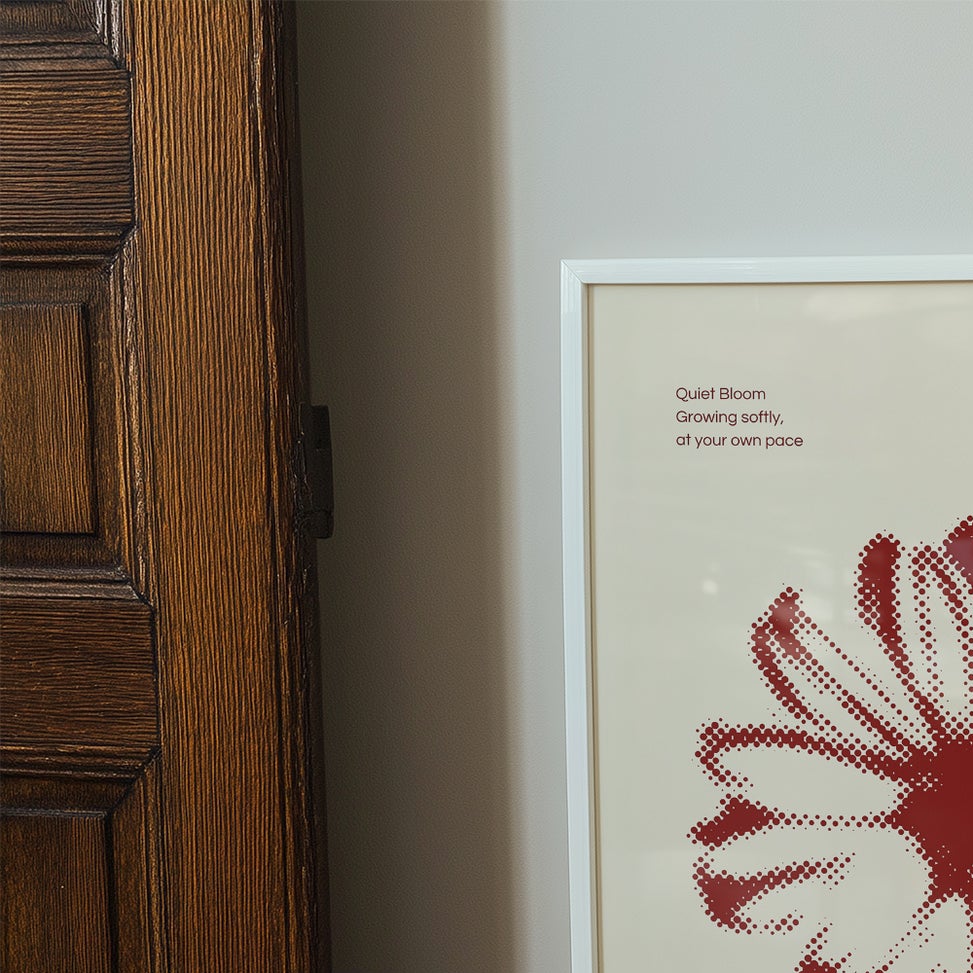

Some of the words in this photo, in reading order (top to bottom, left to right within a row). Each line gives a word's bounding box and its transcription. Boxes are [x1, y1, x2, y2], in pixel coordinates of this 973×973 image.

[675, 386, 715, 403] Quiet
[719, 386, 766, 401] Bloom
[675, 409, 738, 427] Growing
[740, 409, 784, 427] softly,
[675, 433, 692, 446] at
[694, 436, 728, 450] your
[730, 436, 762, 447] own
[765, 436, 804, 450] pace
